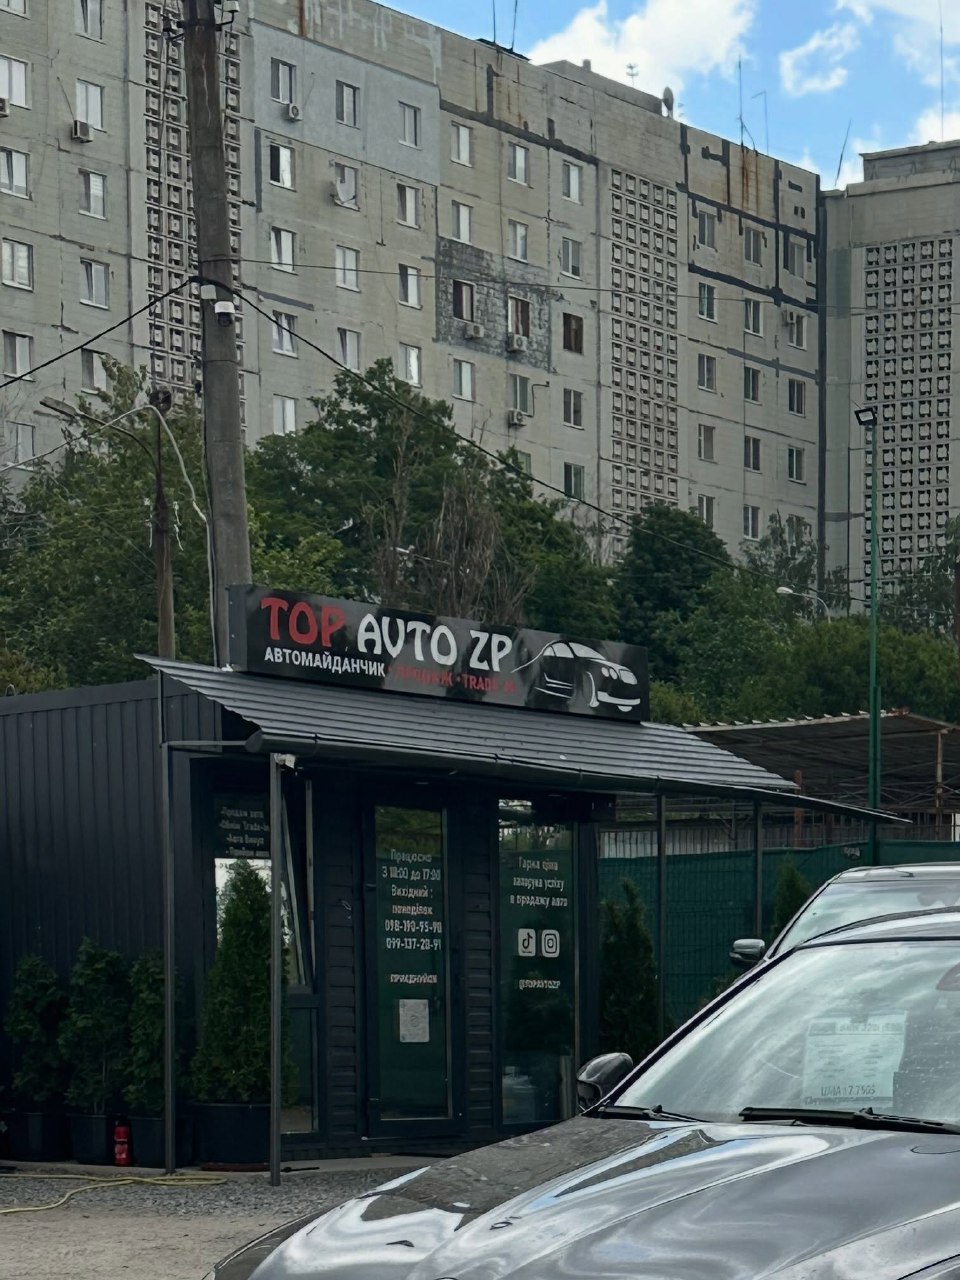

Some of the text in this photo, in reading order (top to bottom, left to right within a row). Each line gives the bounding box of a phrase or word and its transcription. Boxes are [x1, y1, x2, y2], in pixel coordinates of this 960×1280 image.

[261, 597, 346, 648] TOP
[469, 629, 513, 672] ZP
[264, 646, 386, 677] АВТОМАЙДАНЧИК
[410, 870, 420, 881] до
